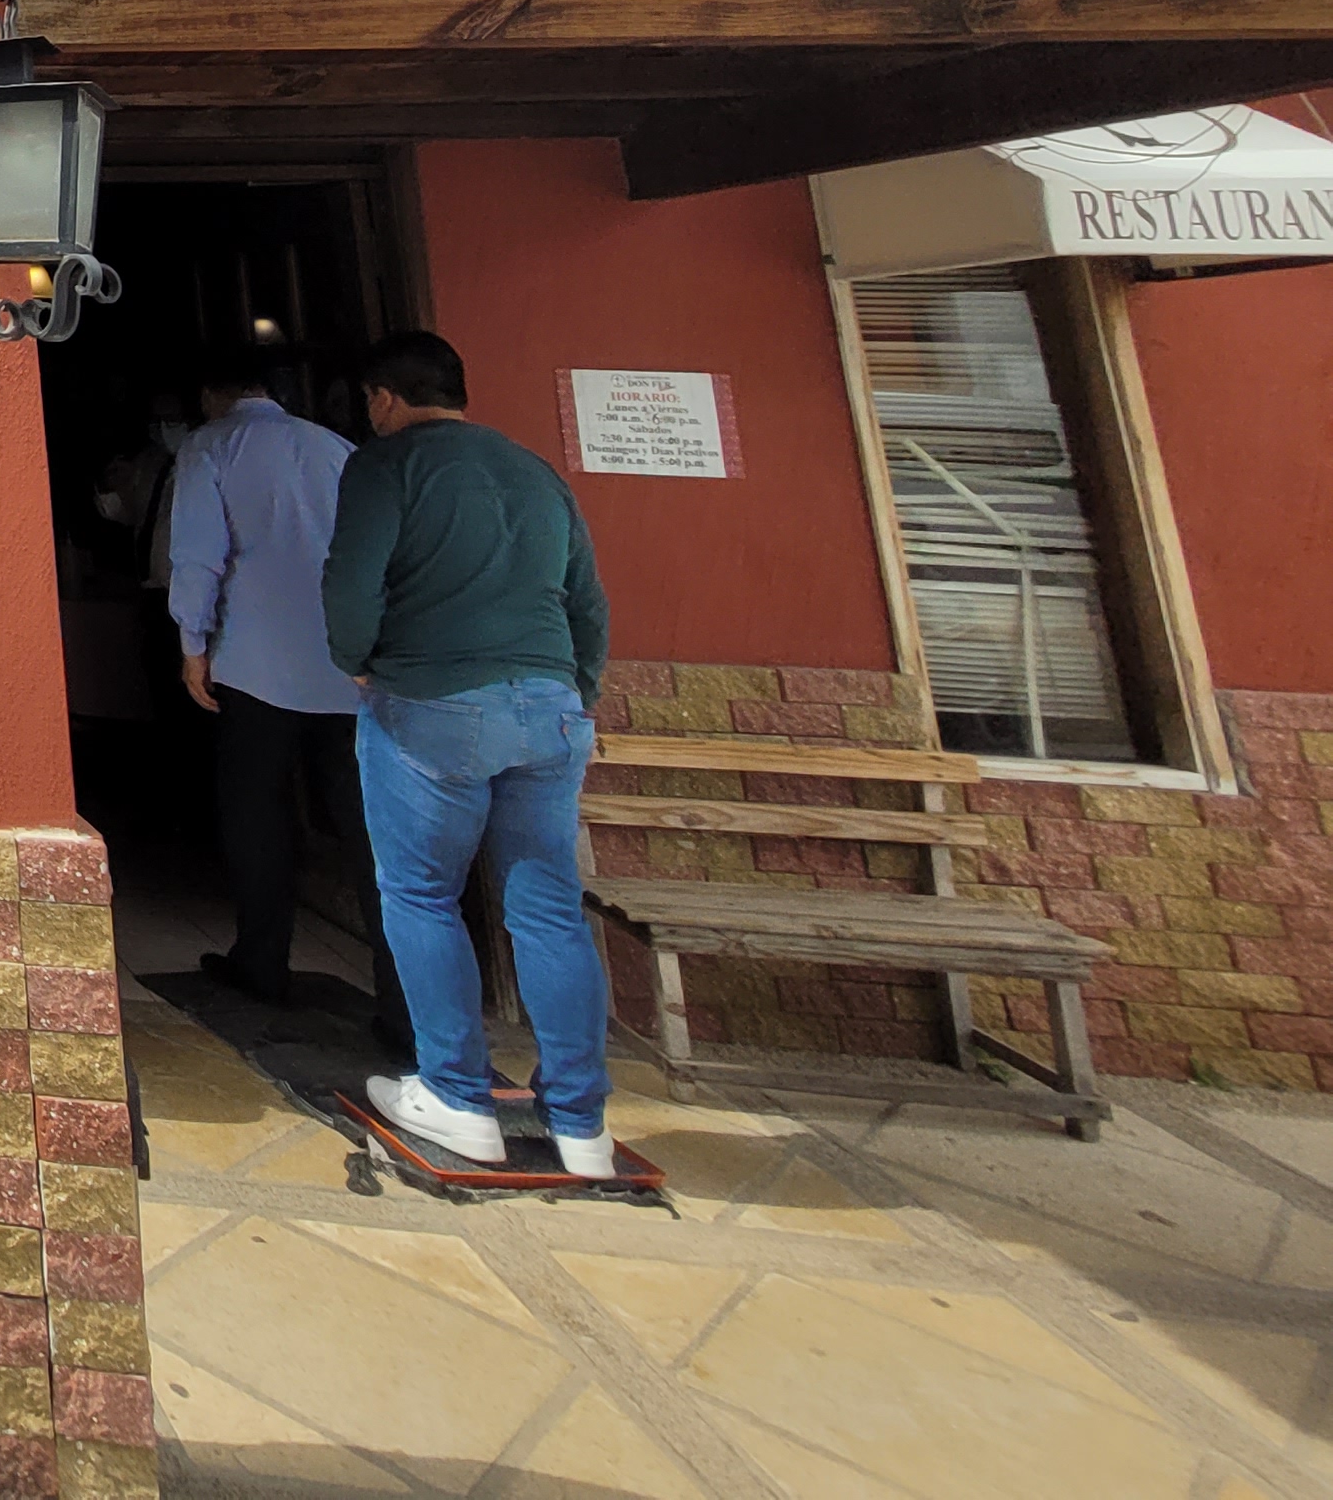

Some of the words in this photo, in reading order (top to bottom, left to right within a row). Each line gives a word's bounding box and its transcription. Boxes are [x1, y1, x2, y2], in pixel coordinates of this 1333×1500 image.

[611, 391, 681, 404] HORARIO:
[606, 403, 639, 412] Lunes
[649, 404, 689, 414] Viernes
[595, 413, 618, 421] 7:00
[679, 417, 701, 426] p.m.
[586, 443, 640, 455] Domingos
